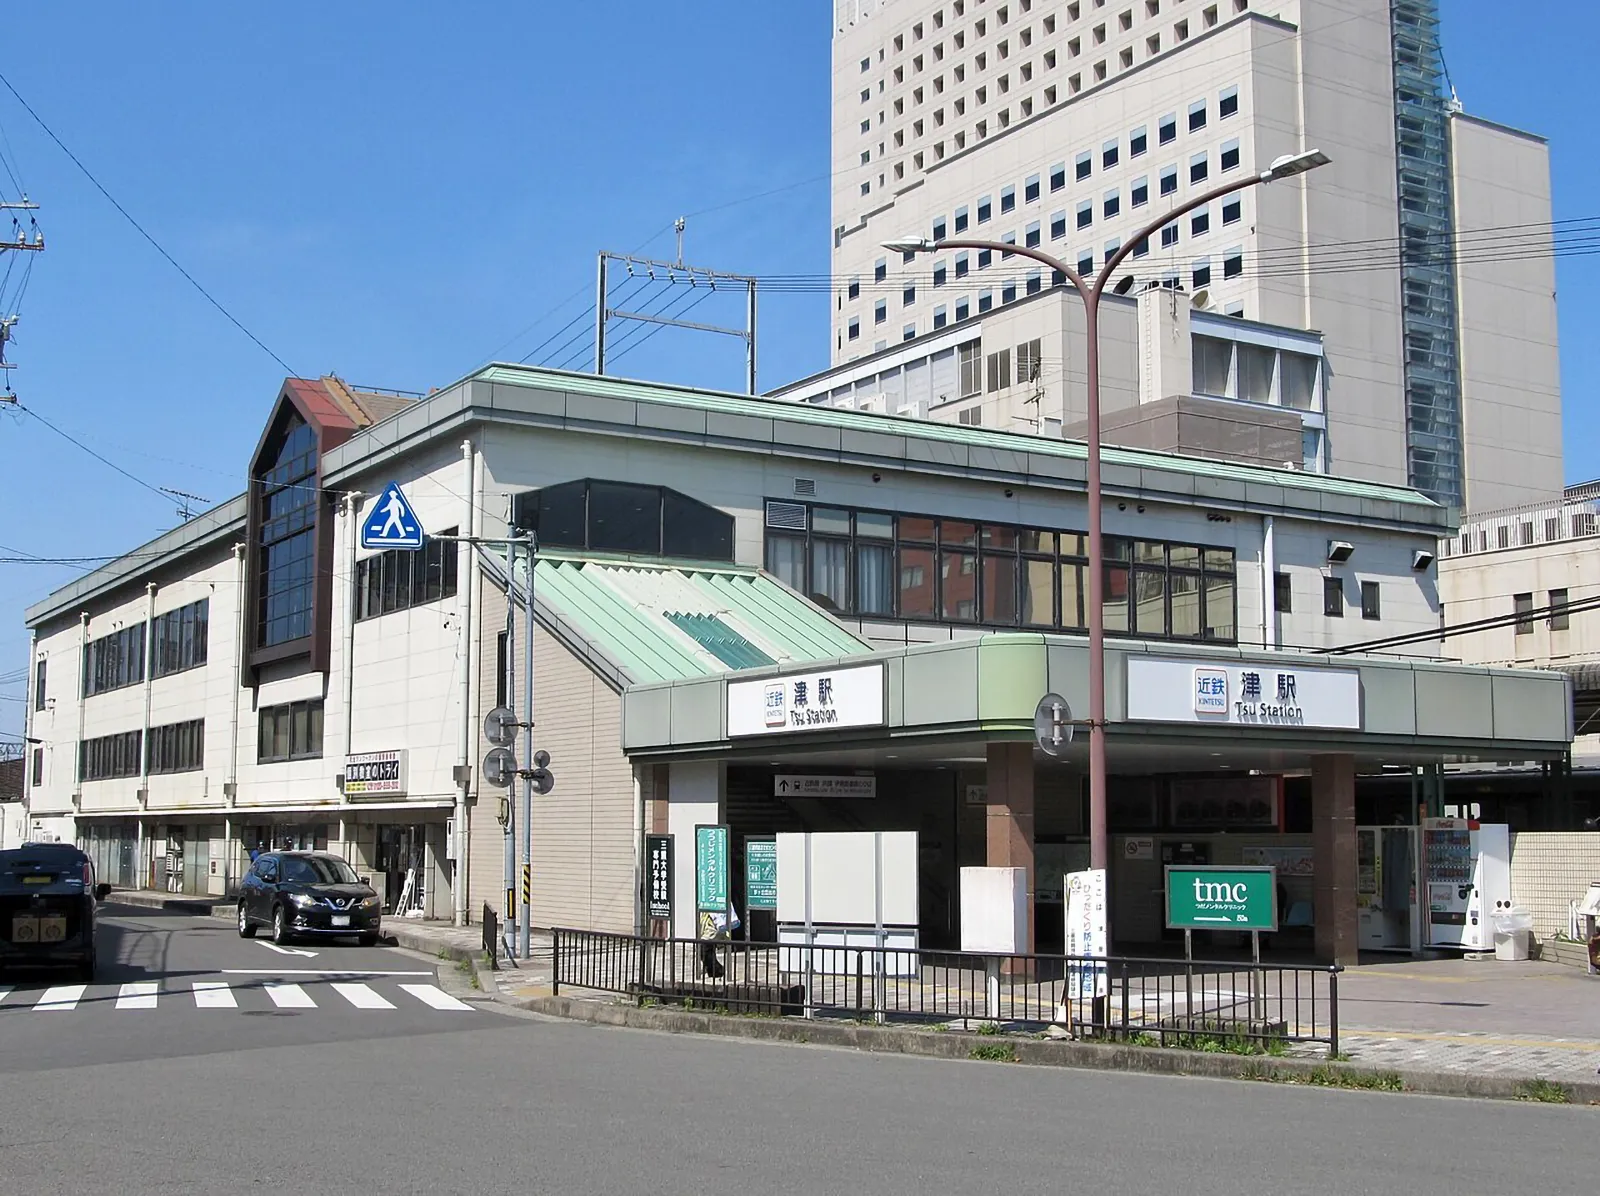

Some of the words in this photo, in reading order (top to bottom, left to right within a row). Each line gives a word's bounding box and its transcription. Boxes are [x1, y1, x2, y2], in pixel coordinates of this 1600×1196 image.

[1197, 677, 1225, 695] 近鉄
[766, 692, 783, 708] 近鉄
[1198, 698, 1225, 706] KINTETSU
[790, 709, 806, 726] Tsu
[806, 708, 838, 725] Station
[1235, 702, 1256, 716] Tsu
[1260, 703, 1303, 718] Station
[1192, 877, 1248, 902] tmc
